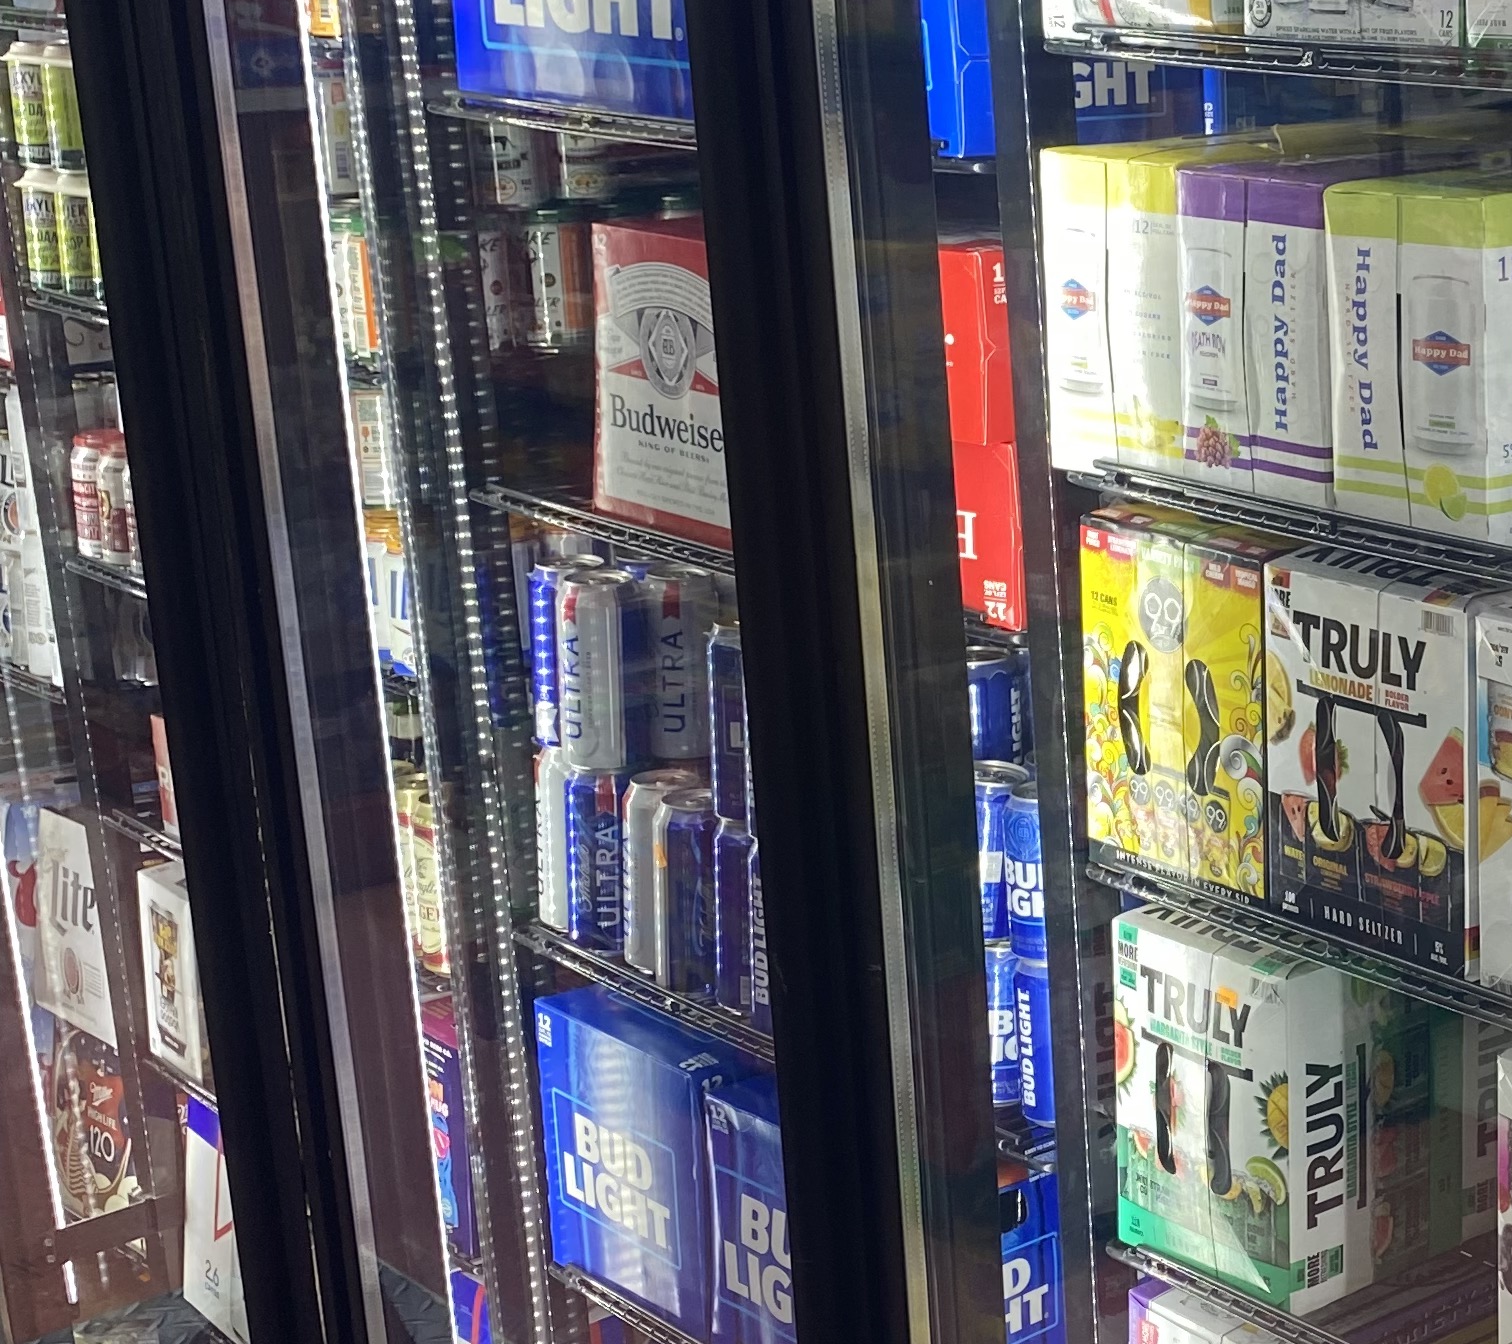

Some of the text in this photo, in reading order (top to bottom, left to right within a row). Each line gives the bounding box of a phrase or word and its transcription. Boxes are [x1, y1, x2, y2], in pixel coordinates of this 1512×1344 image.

[1440, 10, 1453, 28] 12
[1271, 233, 1289, 434] Happy Dad
[1353, 246, 1379, 451] Happy Dad
[1414, 345, 1469, 360] Happy Dad
[610, 394, 724, 452] Budweise
[562, 635, 583, 740] ULTRA
[662, 629, 686, 734] ULTRA
[1293, 610, 1426, 692] TRULY
[1309, 667, 1373, 702] LEMONADE
[51, 858, 96, 937] Lite
[596, 824, 619, 927] ULTRA
[1324, 906, 1403, 946] HARD SELTZER
[537, 1013, 552, 1029] 12
[1140, 964, 1251, 1048] TRULY
[1018, 988, 1036, 1107] BUD LIGHT
[90, 1124, 115, 1163] 120
[574, 1112, 653, 1192] BUD
[1305, 1062, 1344, 1230] TRULY
[563, 1151, 671, 1249] LIGHT
